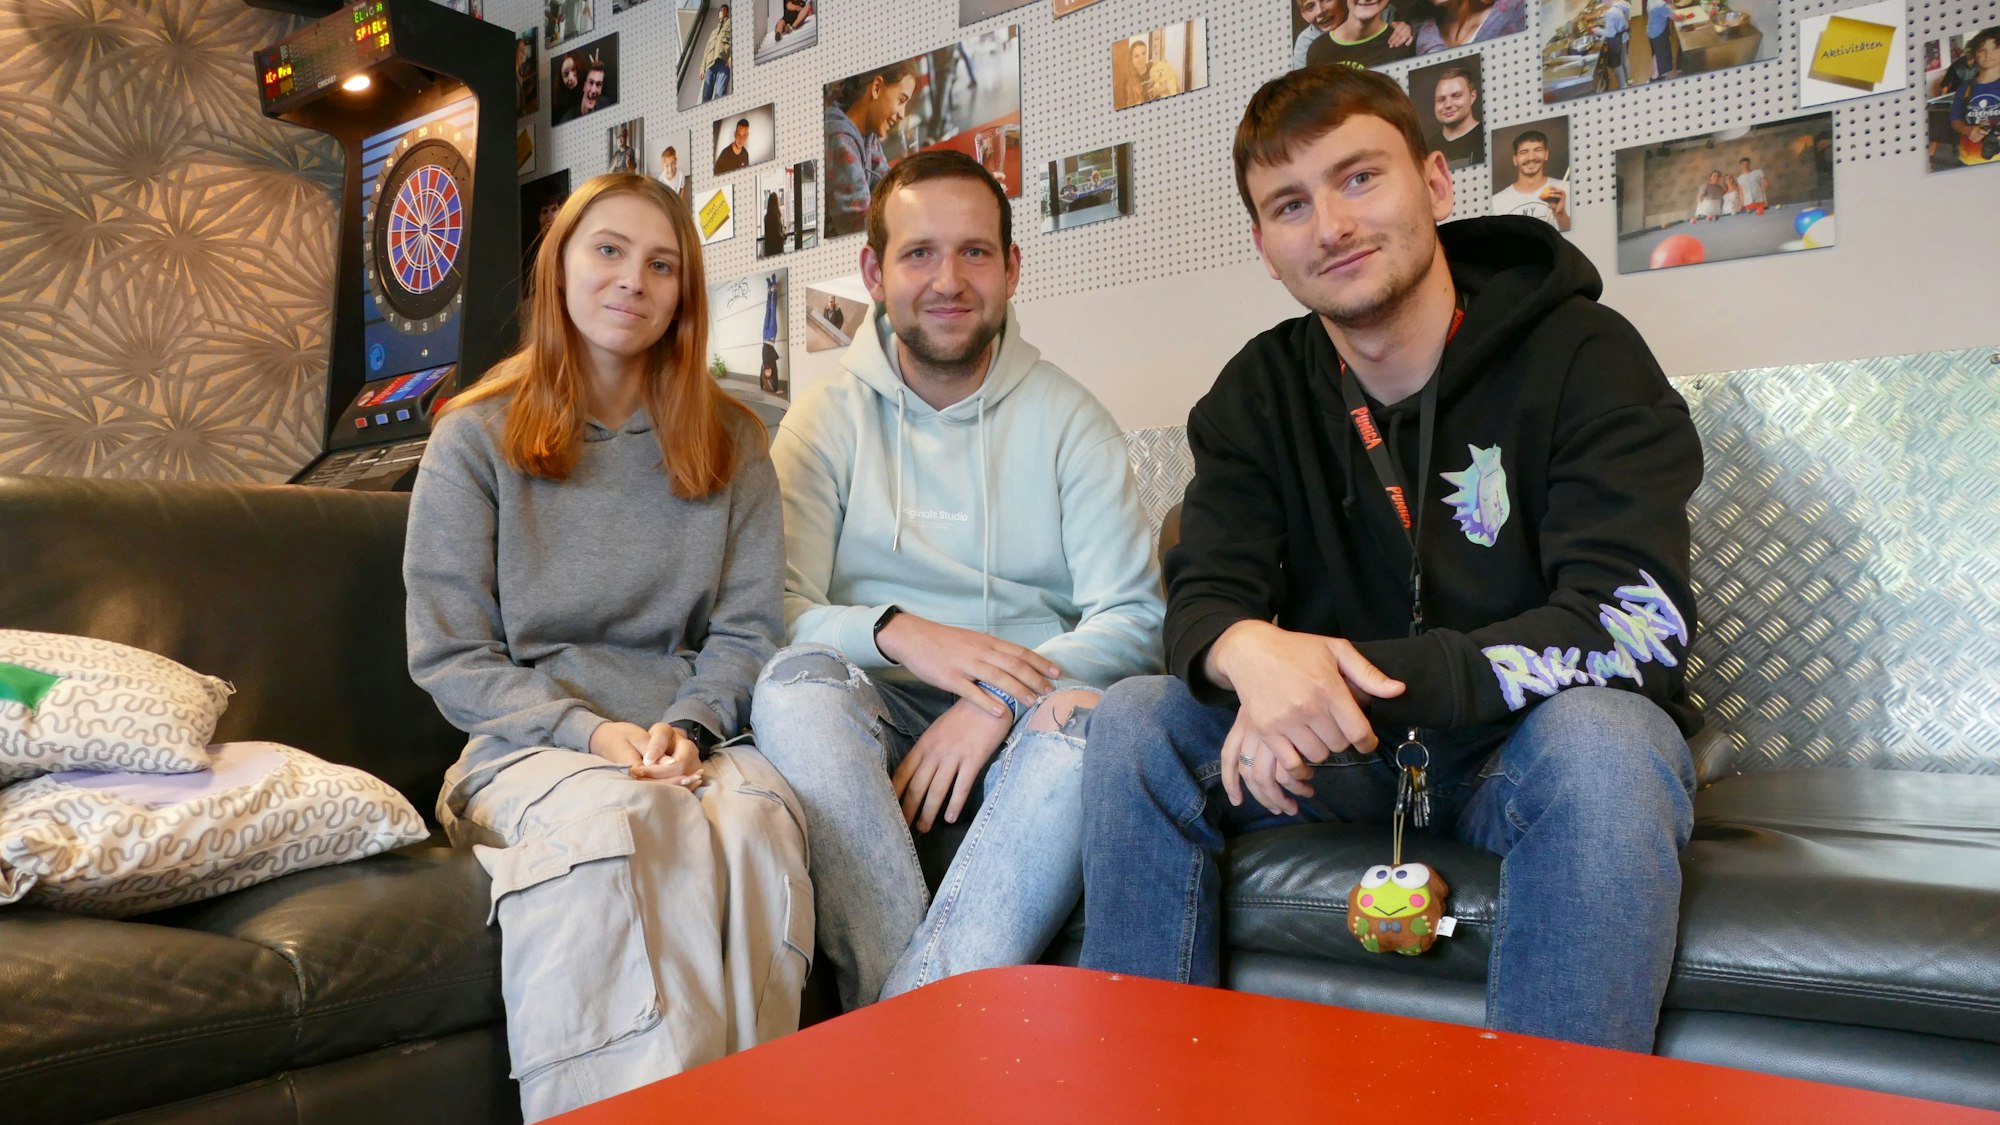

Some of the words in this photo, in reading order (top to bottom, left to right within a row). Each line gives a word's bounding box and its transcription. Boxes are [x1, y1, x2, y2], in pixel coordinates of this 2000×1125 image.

[379, 32, 390, 47] 33
[1821, 41, 1884, 59] Aktivitäten
[939, 511, 968, 521] Studio
